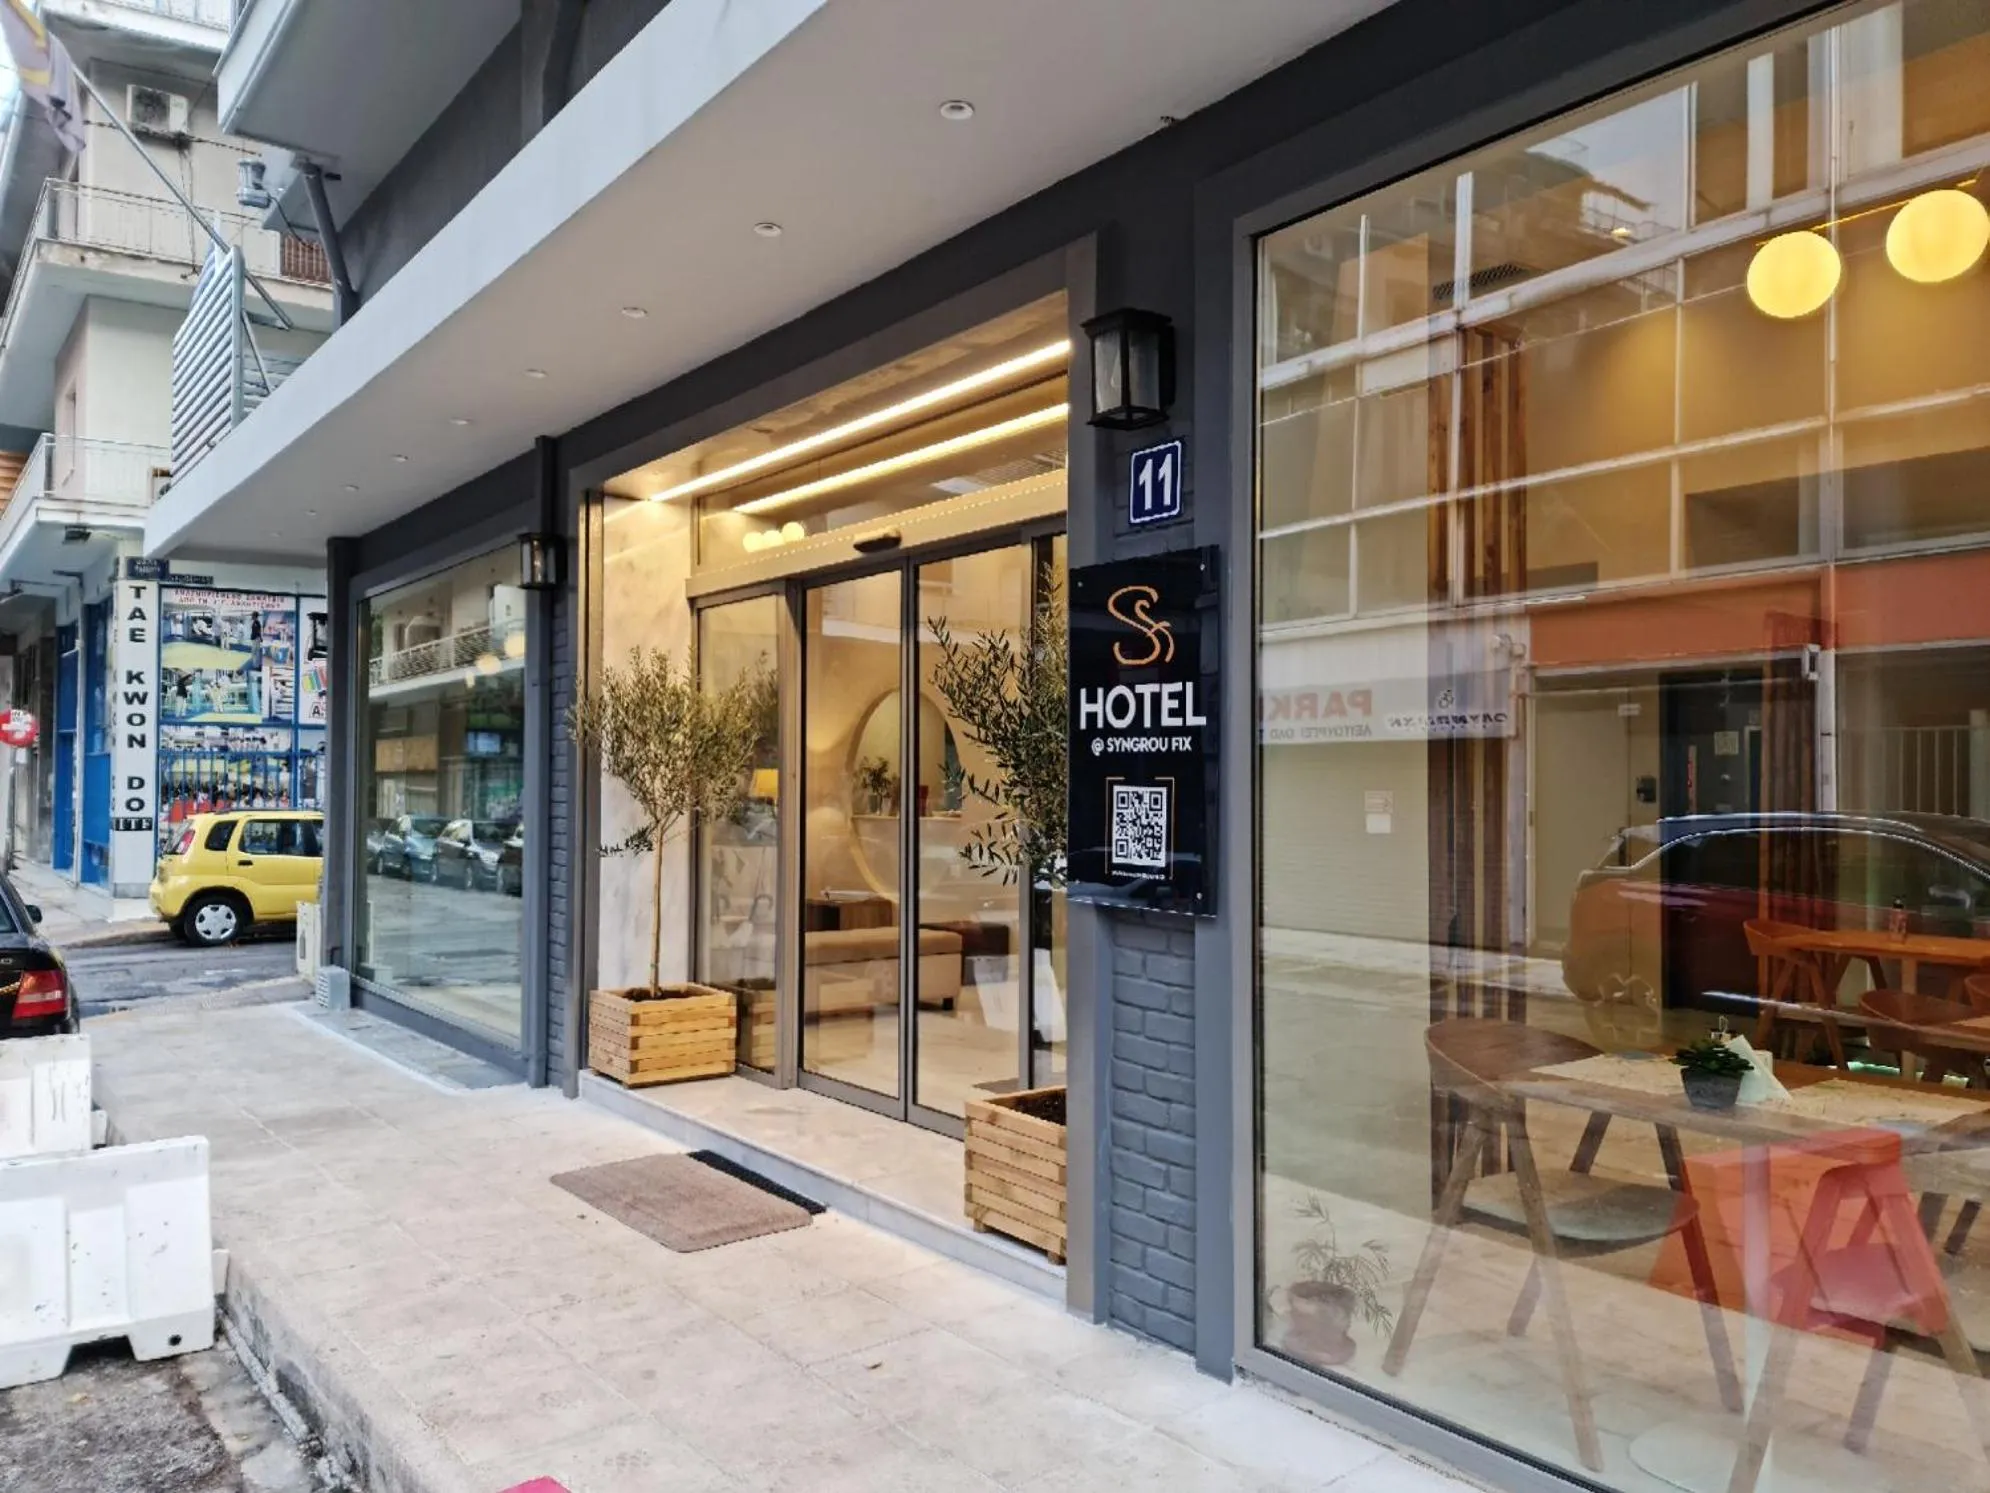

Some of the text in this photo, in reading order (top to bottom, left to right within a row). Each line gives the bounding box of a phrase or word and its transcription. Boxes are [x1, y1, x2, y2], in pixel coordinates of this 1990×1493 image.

[1138, 453, 1172, 510] 11
[123, 586, 149, 812] TAE KWON DO
[1080, 681, 1207, 730] HOTEL
[1091, 736, 1192, 756] @ SYNGROU FIX
